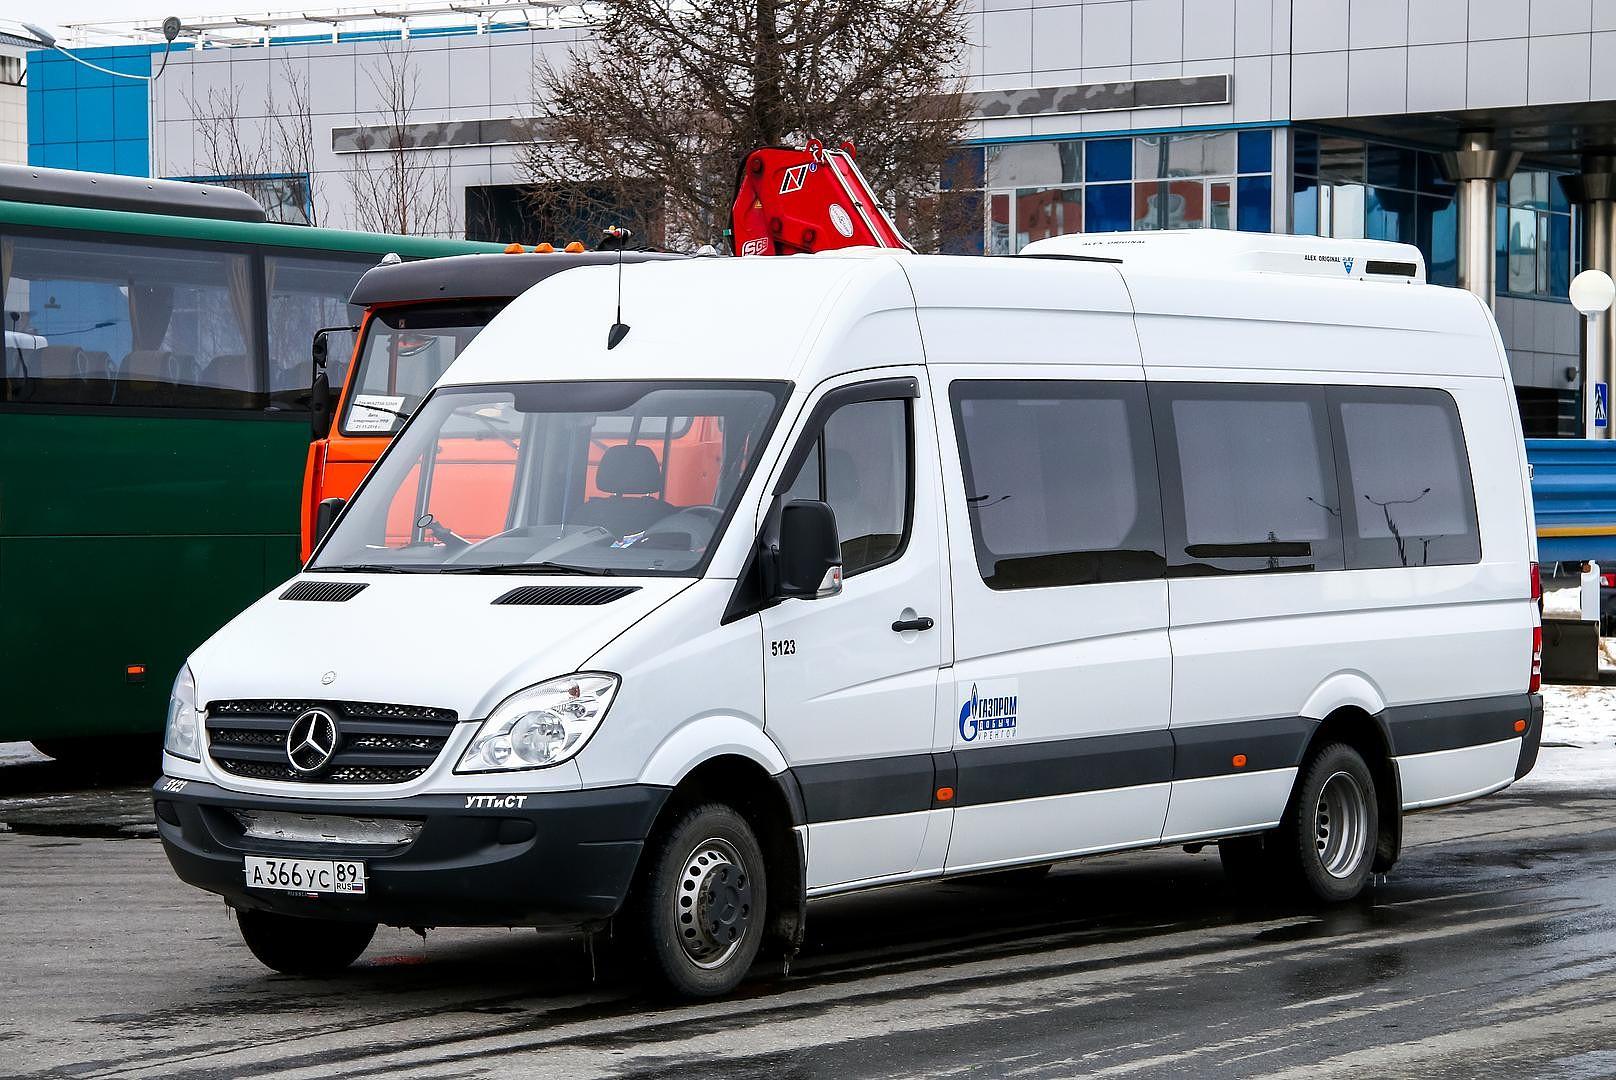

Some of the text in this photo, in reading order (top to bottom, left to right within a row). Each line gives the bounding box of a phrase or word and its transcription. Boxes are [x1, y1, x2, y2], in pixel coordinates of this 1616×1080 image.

[1318, 255, 1341, 263] ORIGINAL
[771, 639, 796, 657] 5123
[979, 695, 1017, 719] ГАЗПРОМ
[162, 779, 188, 793] 5123
[464, 795, 528, 809] УТТиСТ
[336, 864, 357, 883] 89
[336, 882, 352, 891] RUS
